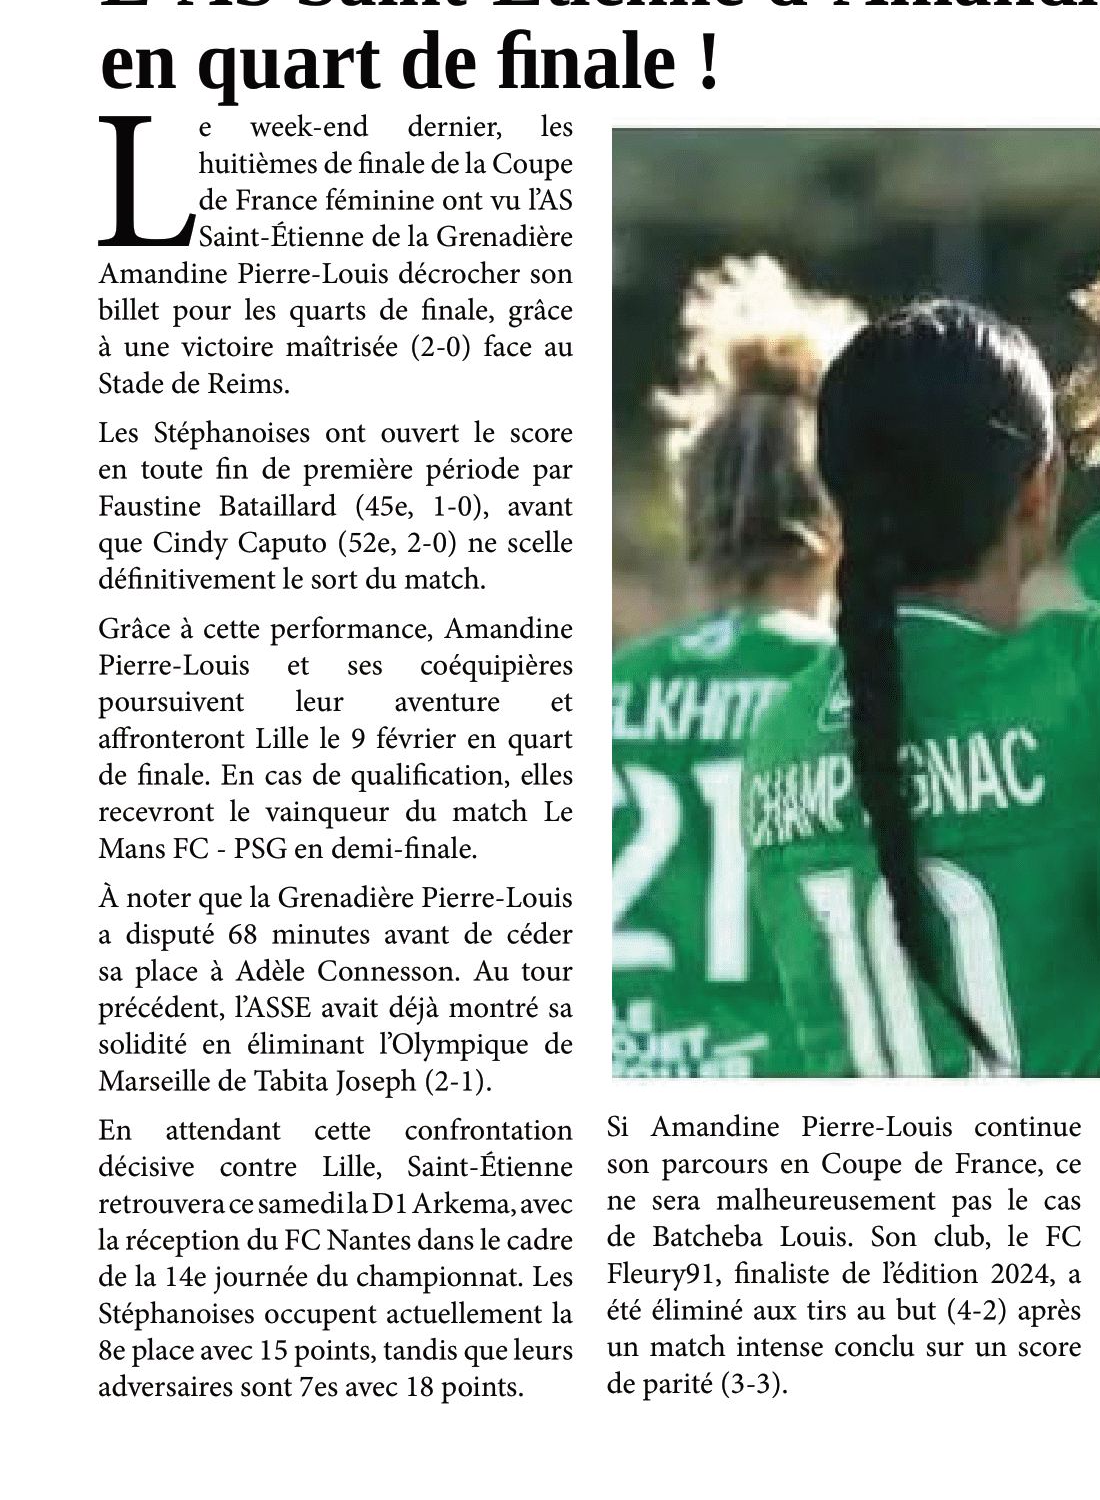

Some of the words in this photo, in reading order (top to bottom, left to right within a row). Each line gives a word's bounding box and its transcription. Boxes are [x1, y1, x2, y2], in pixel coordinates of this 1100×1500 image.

[101, 48, 177, 90] en
[198, 40, 382, 107] quart
[402, 29, 476, 90] de
[496, 28, 675, 90] finale
[701, 32, 716, 90] !
[198, 121, 212, 137] e
[249, 113, 369, 138] week-end
[408, 113, 502, 141] dernier,
[540, 113, 573, 137] les
[97, 260, 228, 285] Amandine
[237, 262, 389, 285] Pierre-Louis
[398, 260, 521, 284] décrocher
[530, 268, 574, 284] son
[98, 494, 201, 517] Faustine
[219, 493, 337, 517] Bataillard
[355, 493, 414, 521] (45e,
[434, 493, 489, 521] 1-0),
[508, 497, 573, 517] avant
[612, 758, 748, 982] 21
[98, 994, 225, 1026] précédent,
[234, 994, 312, 1019] l’ASSE
[321, 996, 379, 1018] avait
[389, 994, 440, 1026] déjà
[448, 995, 539, 1019] montré
[548, 1002, 574, 1018] sa
[607, 1260, 722, 1292] Fleury91,
[734, 1260, 830, 1285] finaliste
[842, 1260, 871, 1285] de
[882, 1260, 979, 1284] l’édition
[990, 1262, 1056, 1287] 2024,
[1068, 1268, 1082, 1284] a
[98, 1373, 233, 1397] adversaires
[240, 1378, 293, 1397] sont
[299, 1376, 338, 1397] 7es
[345, 1381, 398, 1397] avec
[407, 1376, 434, 1397] 18
[441, 1375, 524, 1405] points.
